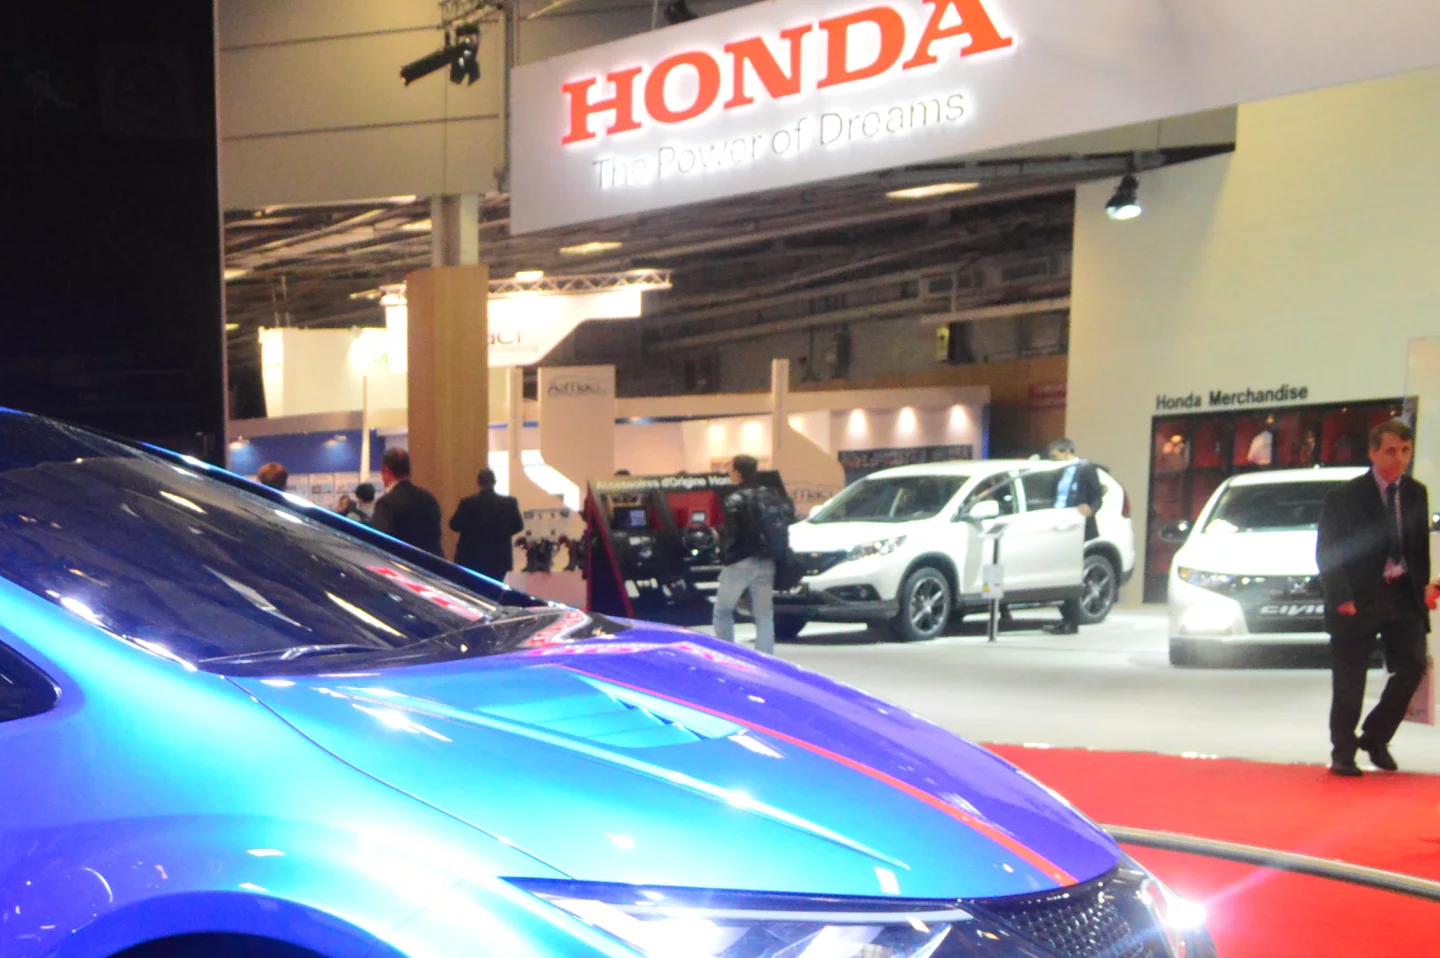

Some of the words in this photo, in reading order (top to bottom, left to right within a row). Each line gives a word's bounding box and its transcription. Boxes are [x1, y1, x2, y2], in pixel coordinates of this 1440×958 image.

[561, 0, 1013, 145] HONDA
[592, 155, 647, 189] The
[657, 134, 764, 179] Power
[771, 115, 810, 156] of
[819, 92, 966, 146] Dreams
[1156, 392, 1202, 410] Honda
[1208, 384, 1309, 406] Merchandise
[662, 476, 706, 489] d'Origine
